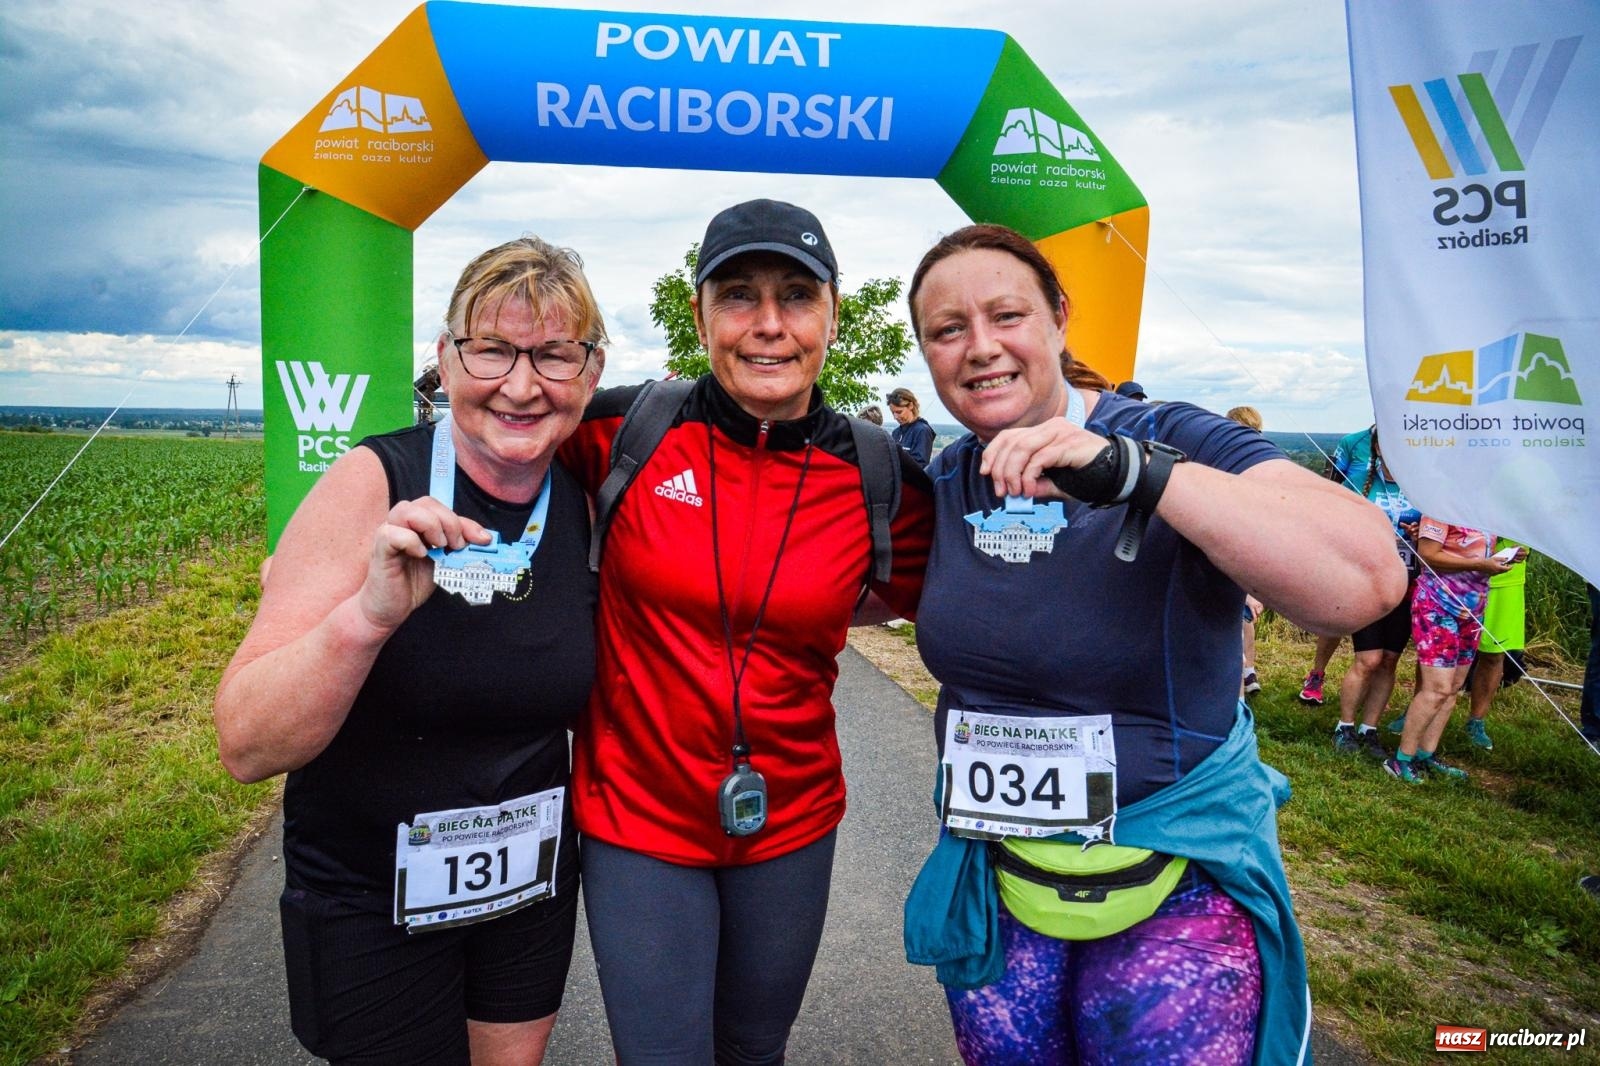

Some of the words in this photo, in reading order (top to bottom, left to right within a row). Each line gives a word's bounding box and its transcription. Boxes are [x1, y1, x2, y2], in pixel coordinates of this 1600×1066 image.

[595, 22, 842, 68] POWIAT
[536, 82, 894, 141] RACIBORSKI
[315, 136, 359, 150] powiat
[368, 138, 434, 152] raciborski
[313, 152, 353, 160] zielona
[361, 154, 391, 162] oaza
[399, 155, 433, 163] kultur
[991, 161, 1038, 174] powiat
[1046, 164, 1106, 180] raciborski
[991, 176, 1031, 186] zielona
[1040, 180, 1068, 188] oaza
[1076, 180, 1106, 190] kultur
[298, 435, 352, 459] PCS
[654, 485, 703, 507] adidas
[974, 724, 999, 736] BIEG
[1003, 727, 1022, 739] NA
[1025, 728, 1078, 742] PIĄTKĘ
[987, 741, 1021, 749] POWIECIE
[1021, 743, 1073, 751] RACIBORSKIM
[968, 761, 1066, 810] 034
[438, 819, 469, 833] BIEG
[473, 816, 493, 829] NA
[497, 804, 537, 824] PIĄTKĘ
[454, 831, 490, 841] POWIECIE
[444, 846, 509, 895] 131
[1074, 890, 1091, 898] 4F
